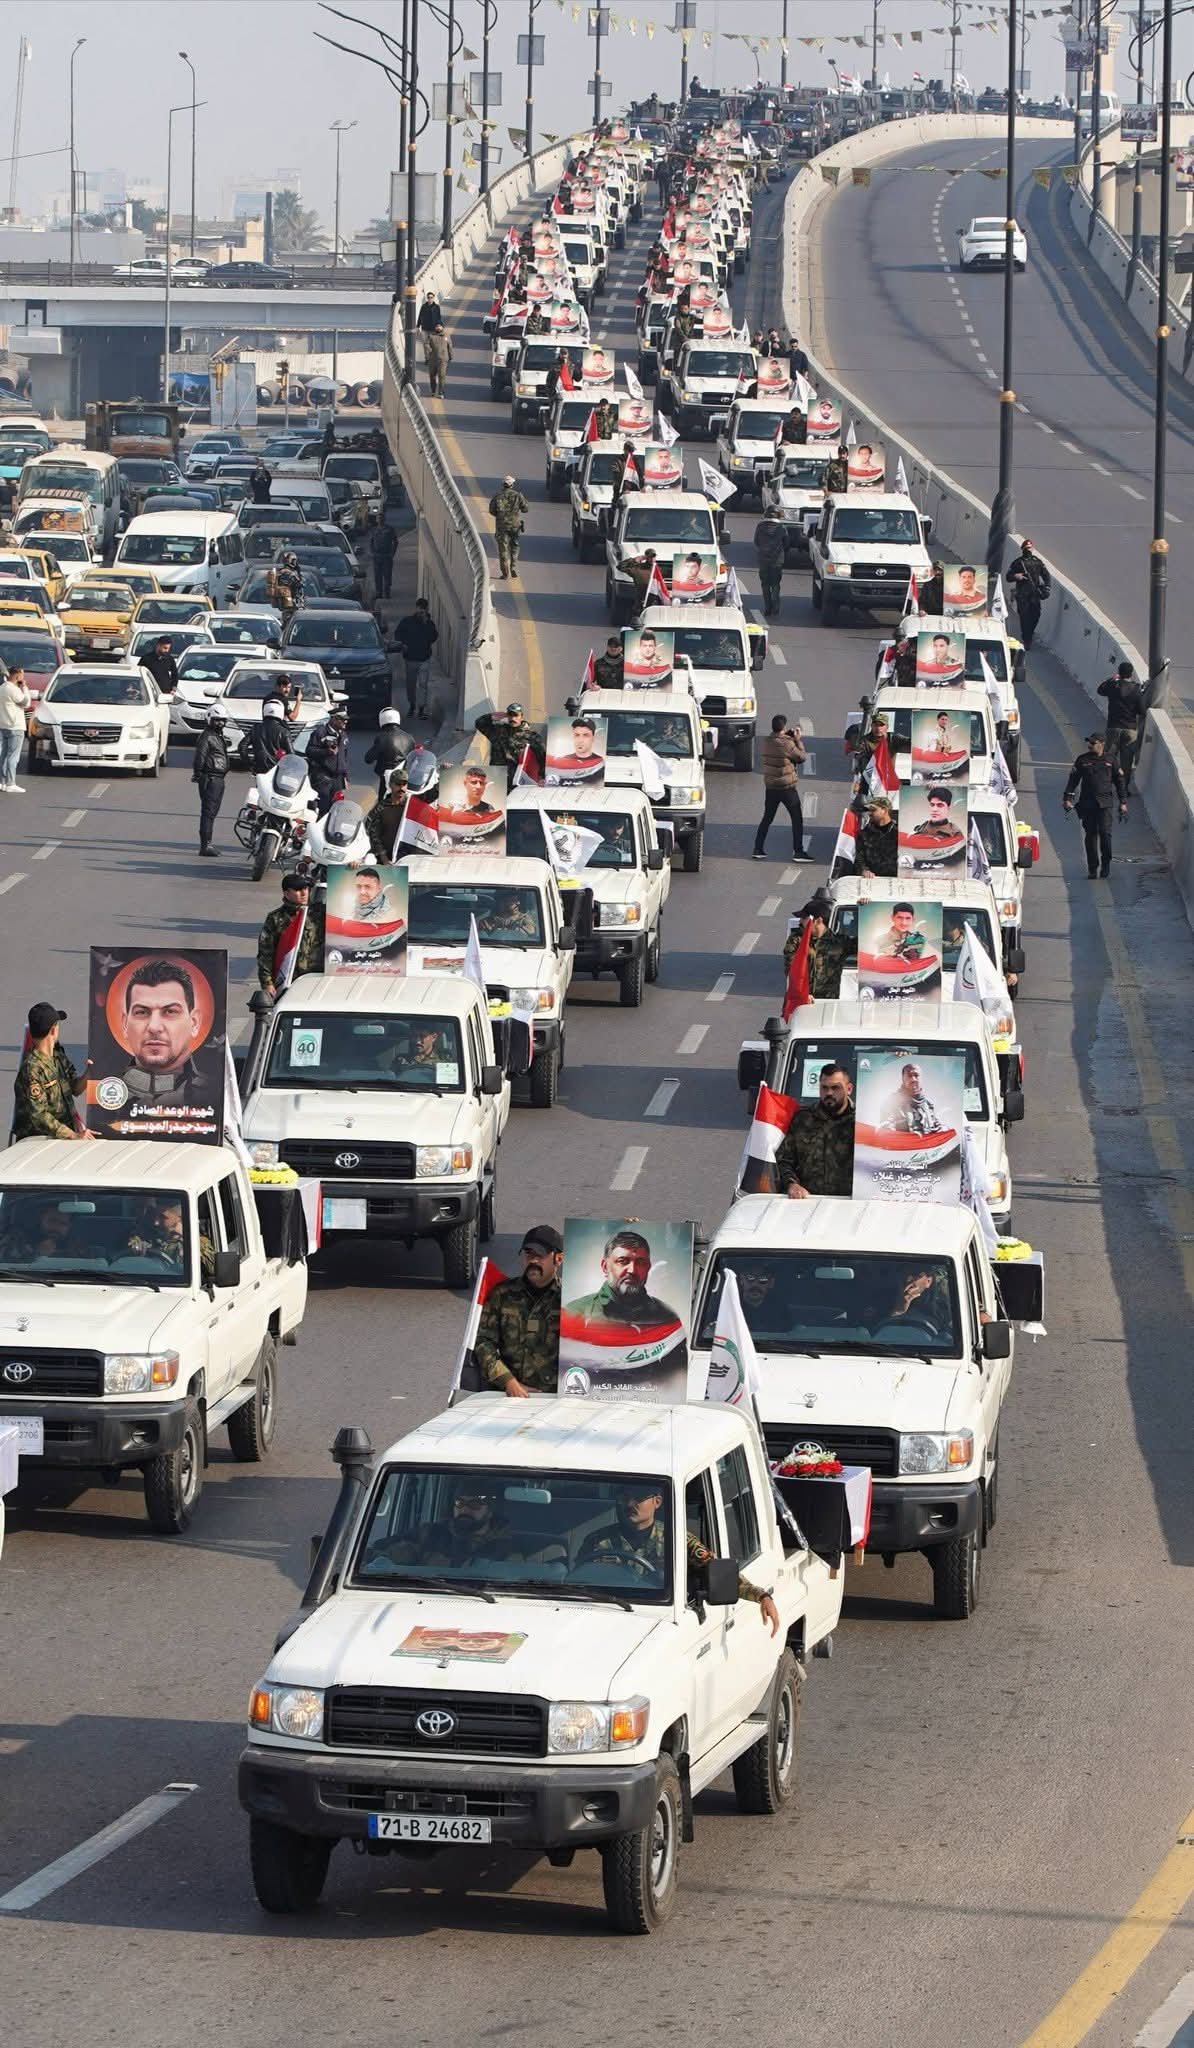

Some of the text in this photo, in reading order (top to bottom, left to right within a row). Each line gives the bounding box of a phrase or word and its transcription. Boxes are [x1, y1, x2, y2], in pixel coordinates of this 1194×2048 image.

[297, 1042, 315, 1053] 40
[809, 1073, 818, 1084] 3
[129, 1103, 215, 1118] شهيد الوعد الصادق
[120, 1120, 217, 1135] سيد حيدر الموسوي
[632, 1384, 658, 1392] الشهيد
[427, 1820, 482, 1840] 24682
